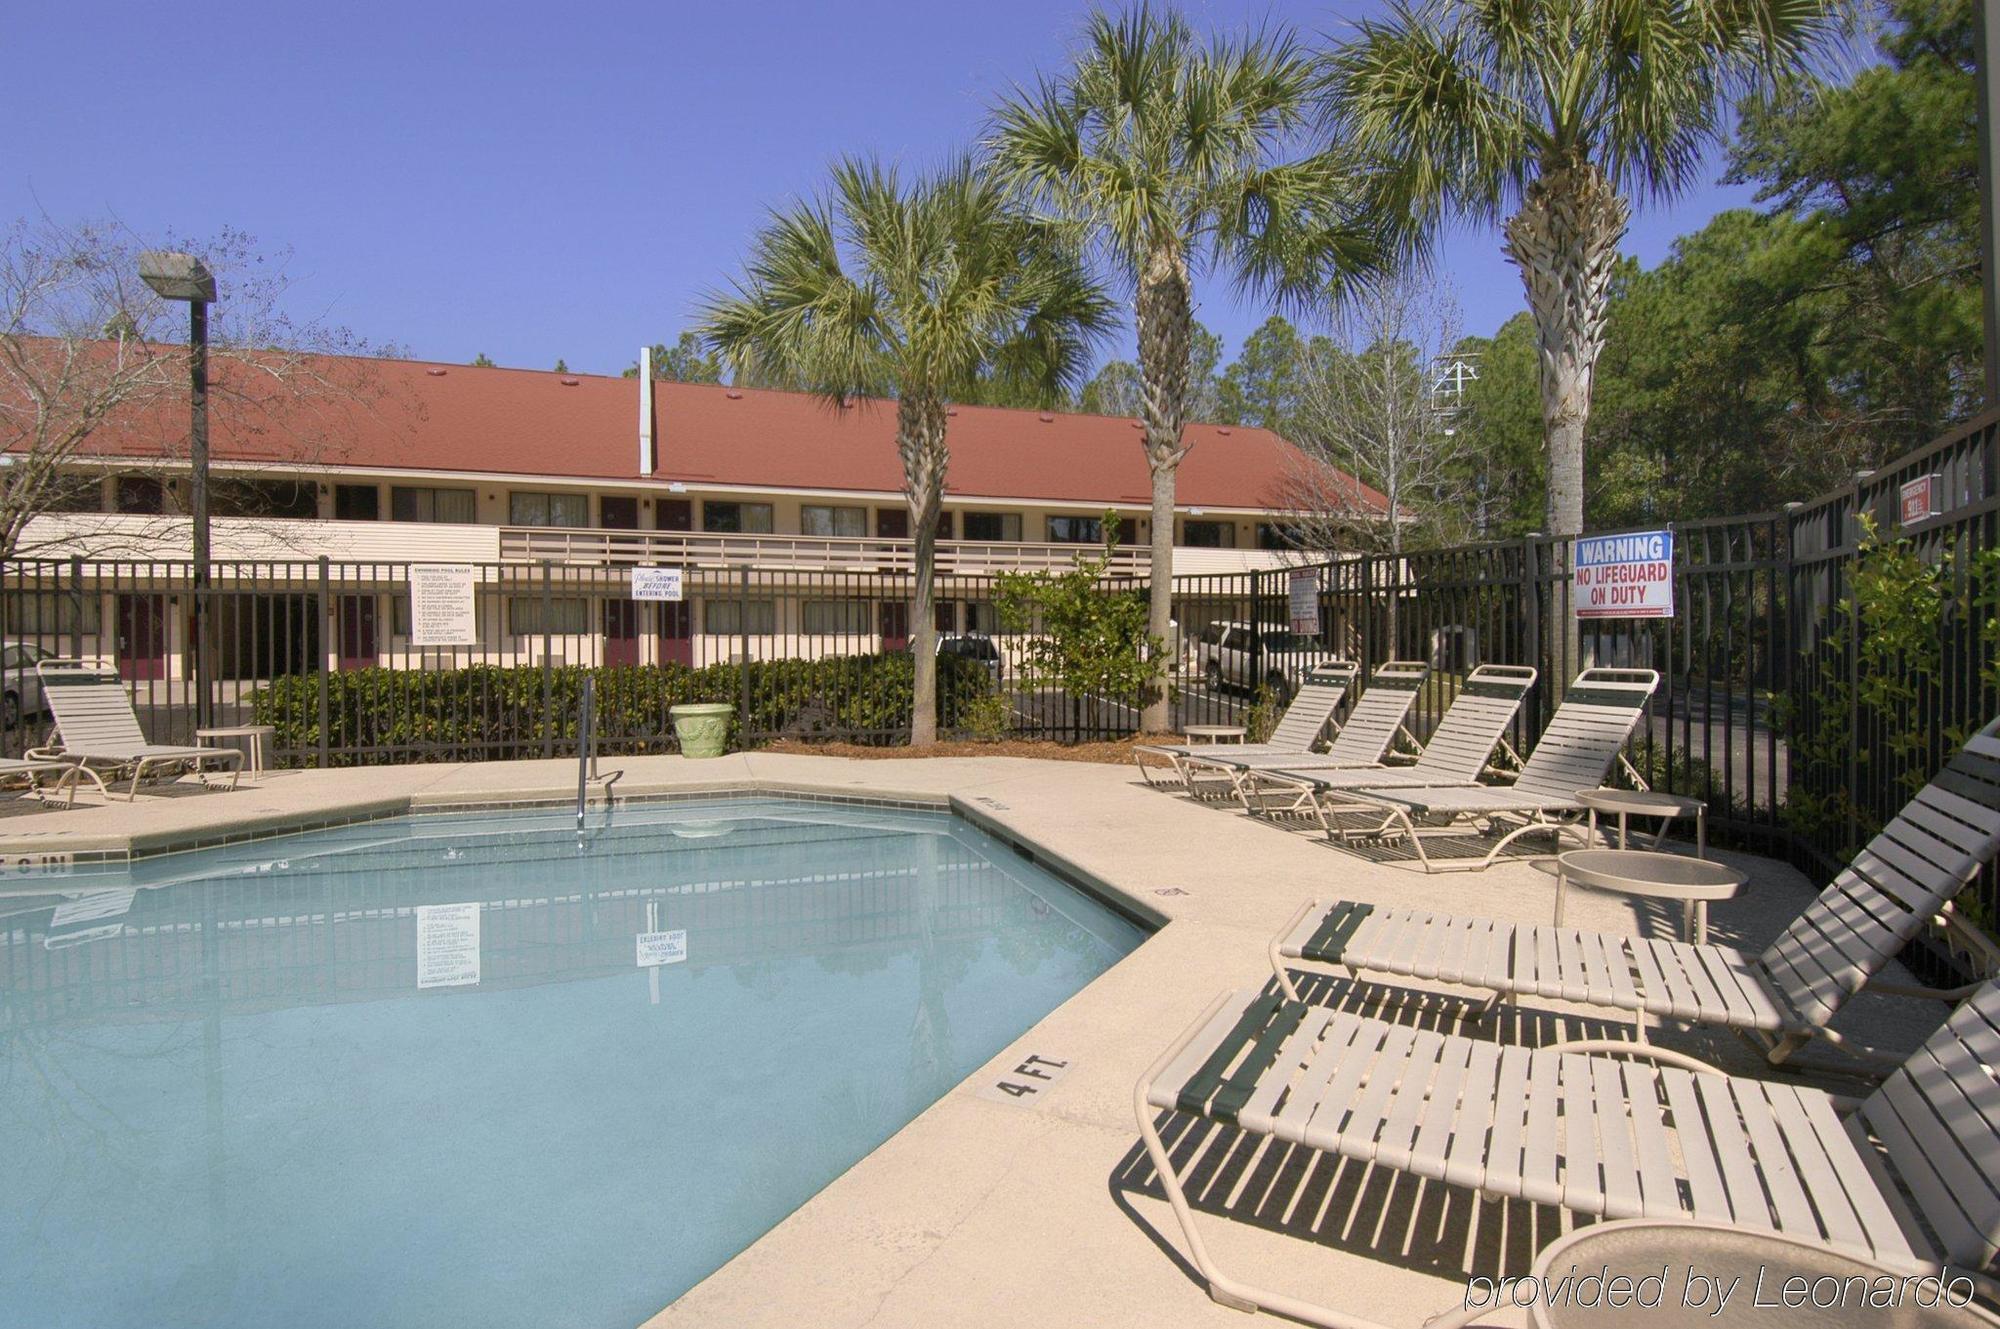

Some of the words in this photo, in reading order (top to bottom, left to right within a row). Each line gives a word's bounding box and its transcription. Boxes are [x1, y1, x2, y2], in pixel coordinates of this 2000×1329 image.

[1582, 535, 1663, 564] WARNING
[655, 575, 680, 583] SHOWER
[1576, 567, 1591, 585] NO
[1596, 562, 1668, 584] LIFEGUARD
[635, 589, 662, 597] ENTERING
[664, 590, 680, 598] POOL
[642, 582, 672, 590] BEFORE
[1591, 587, 1606, 605] ON
[1612, 585, 1647, 604] DUTY
[996, 1081, 1038, 1097] 4
